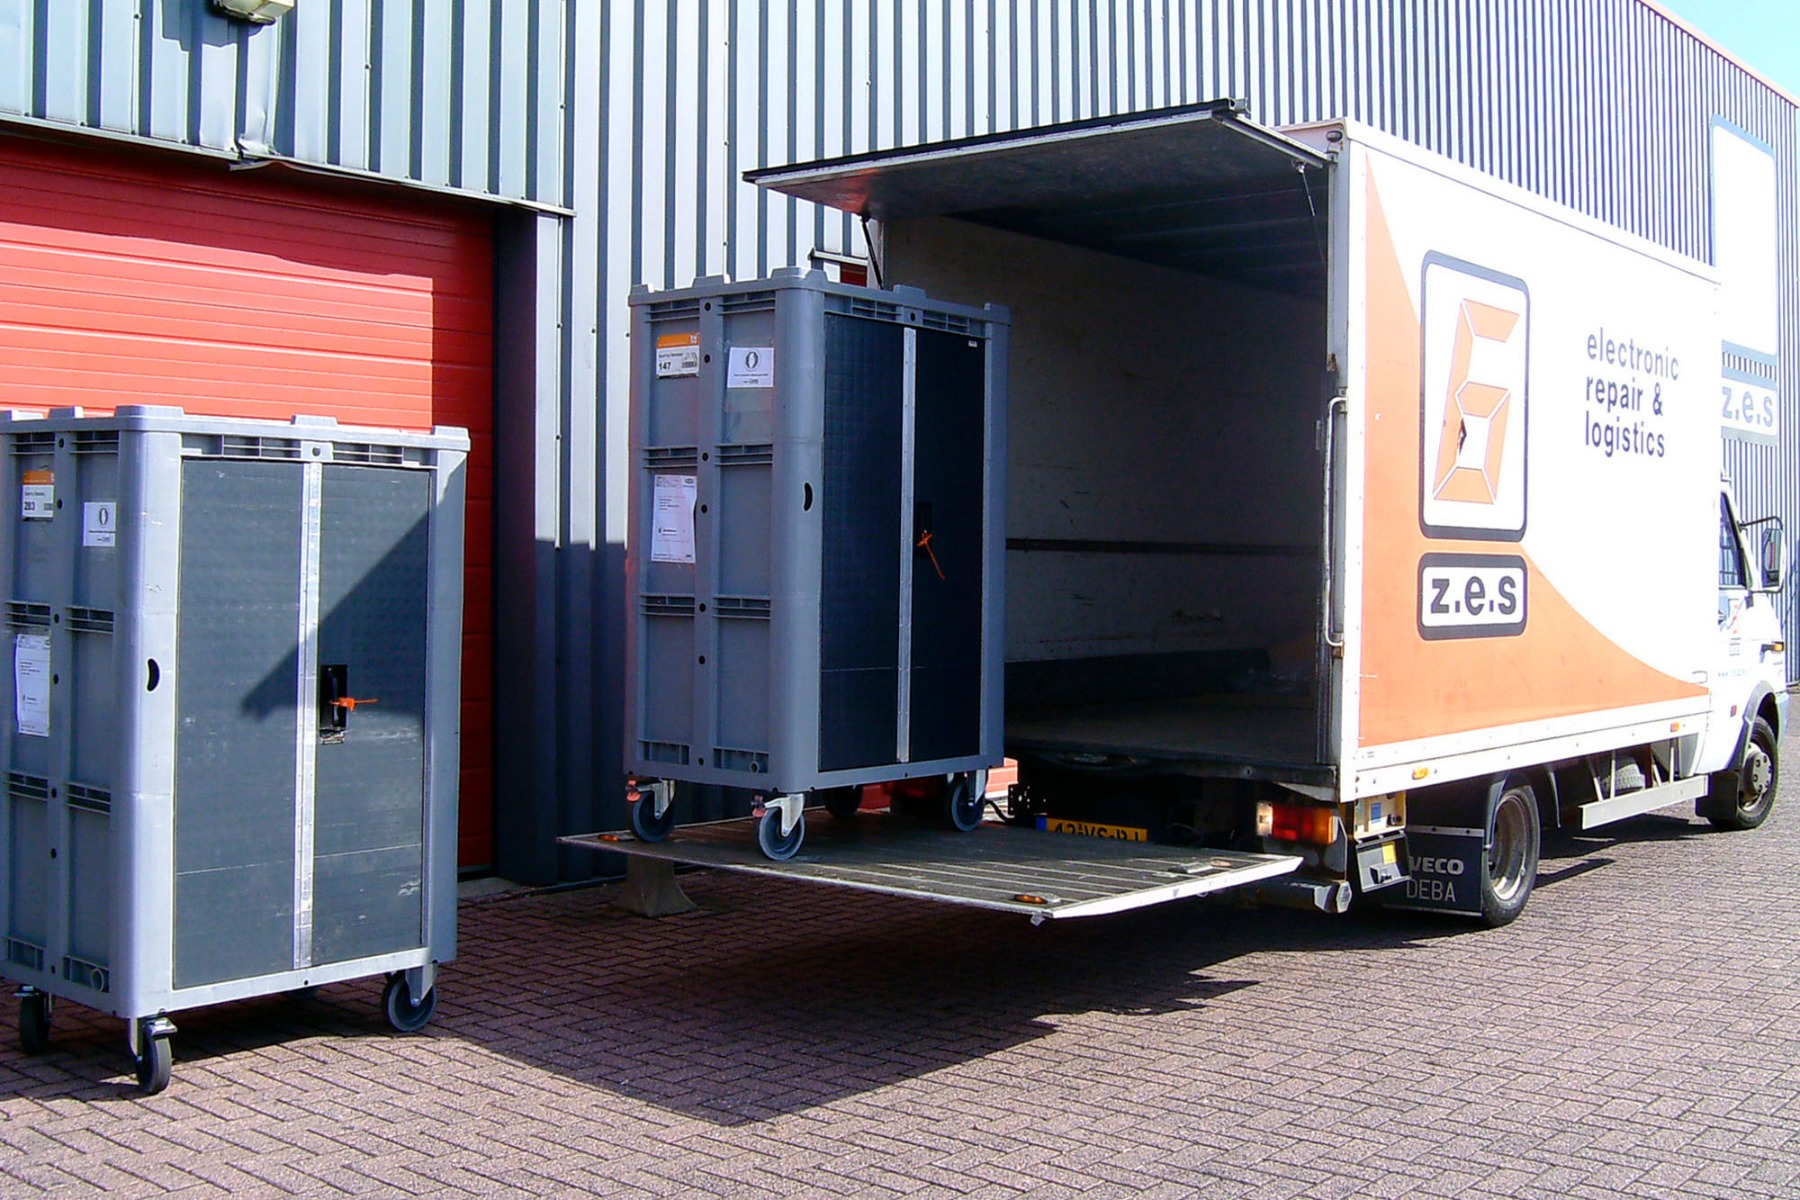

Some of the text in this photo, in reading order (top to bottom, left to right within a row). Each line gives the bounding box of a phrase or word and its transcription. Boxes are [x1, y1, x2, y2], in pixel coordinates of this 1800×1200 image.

[659, 362, 671, 371] 147
[1587, 326, 1679, 381] electronic
[1586, 376, 1663, 416] repair &
[1722, 386, 1773, 427] z.e.s
[1585, 410, 1665, 457] logistics
[1430, 575, 1517, 616] z.e.s
[1409, 856, 1465, 875] VECO
[1406, 879, 1457, 902] DEBA
